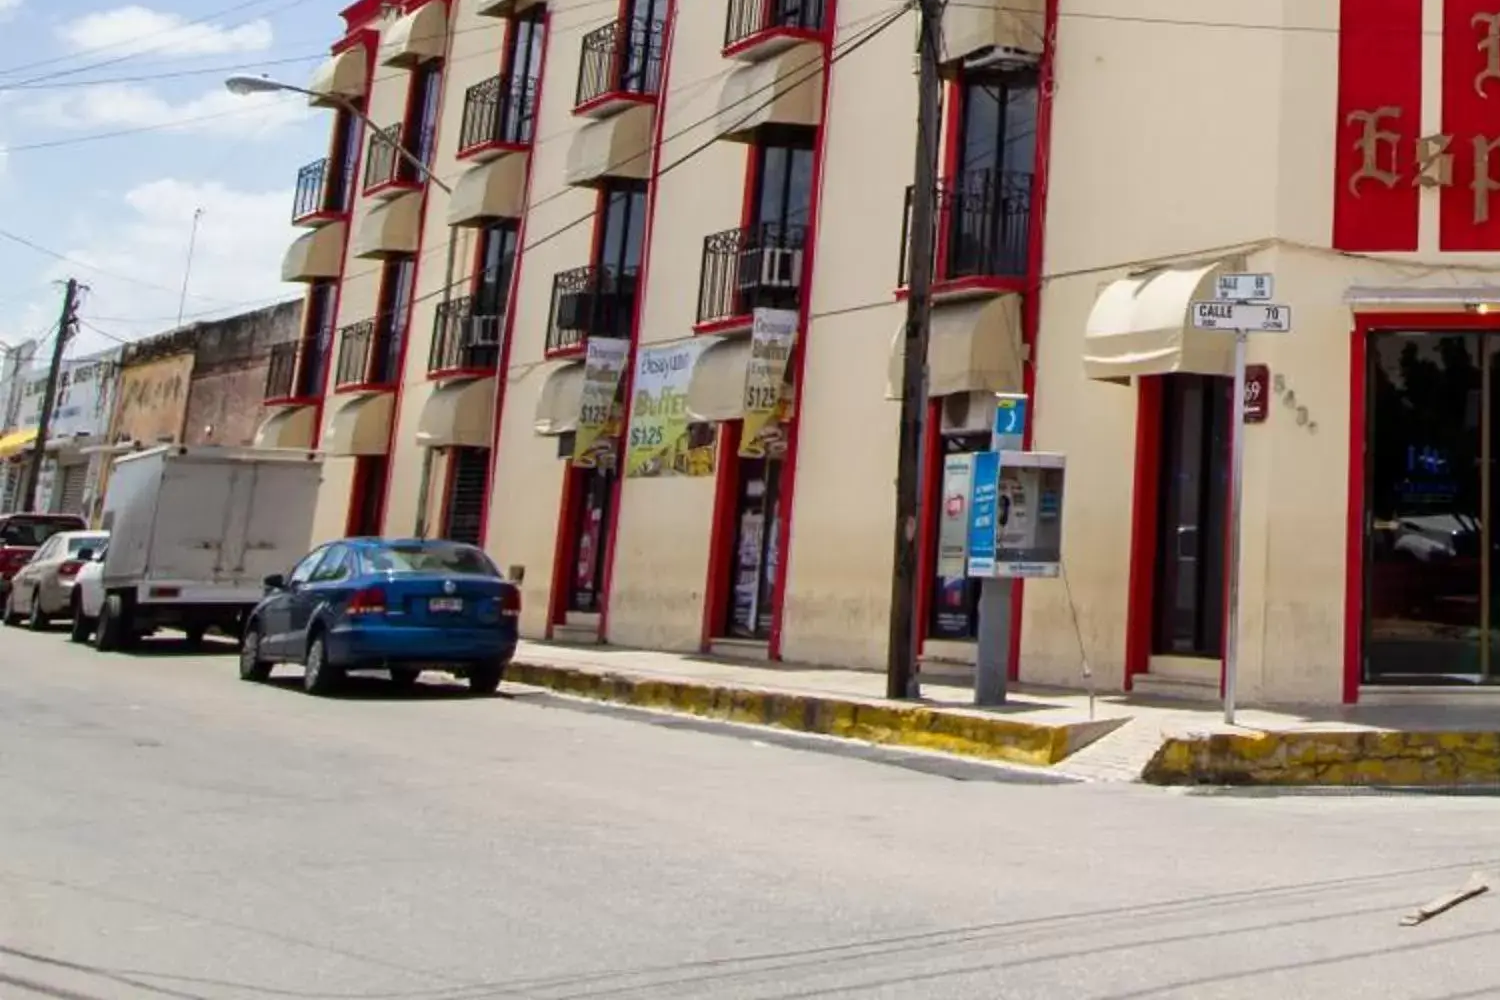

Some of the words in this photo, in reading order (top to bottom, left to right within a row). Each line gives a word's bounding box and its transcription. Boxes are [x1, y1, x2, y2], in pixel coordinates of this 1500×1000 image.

[1199, 305, 1232, 318] CALLE
[1265, 307, 1279, 320] 70
[630, 424, 664, 446] $125
